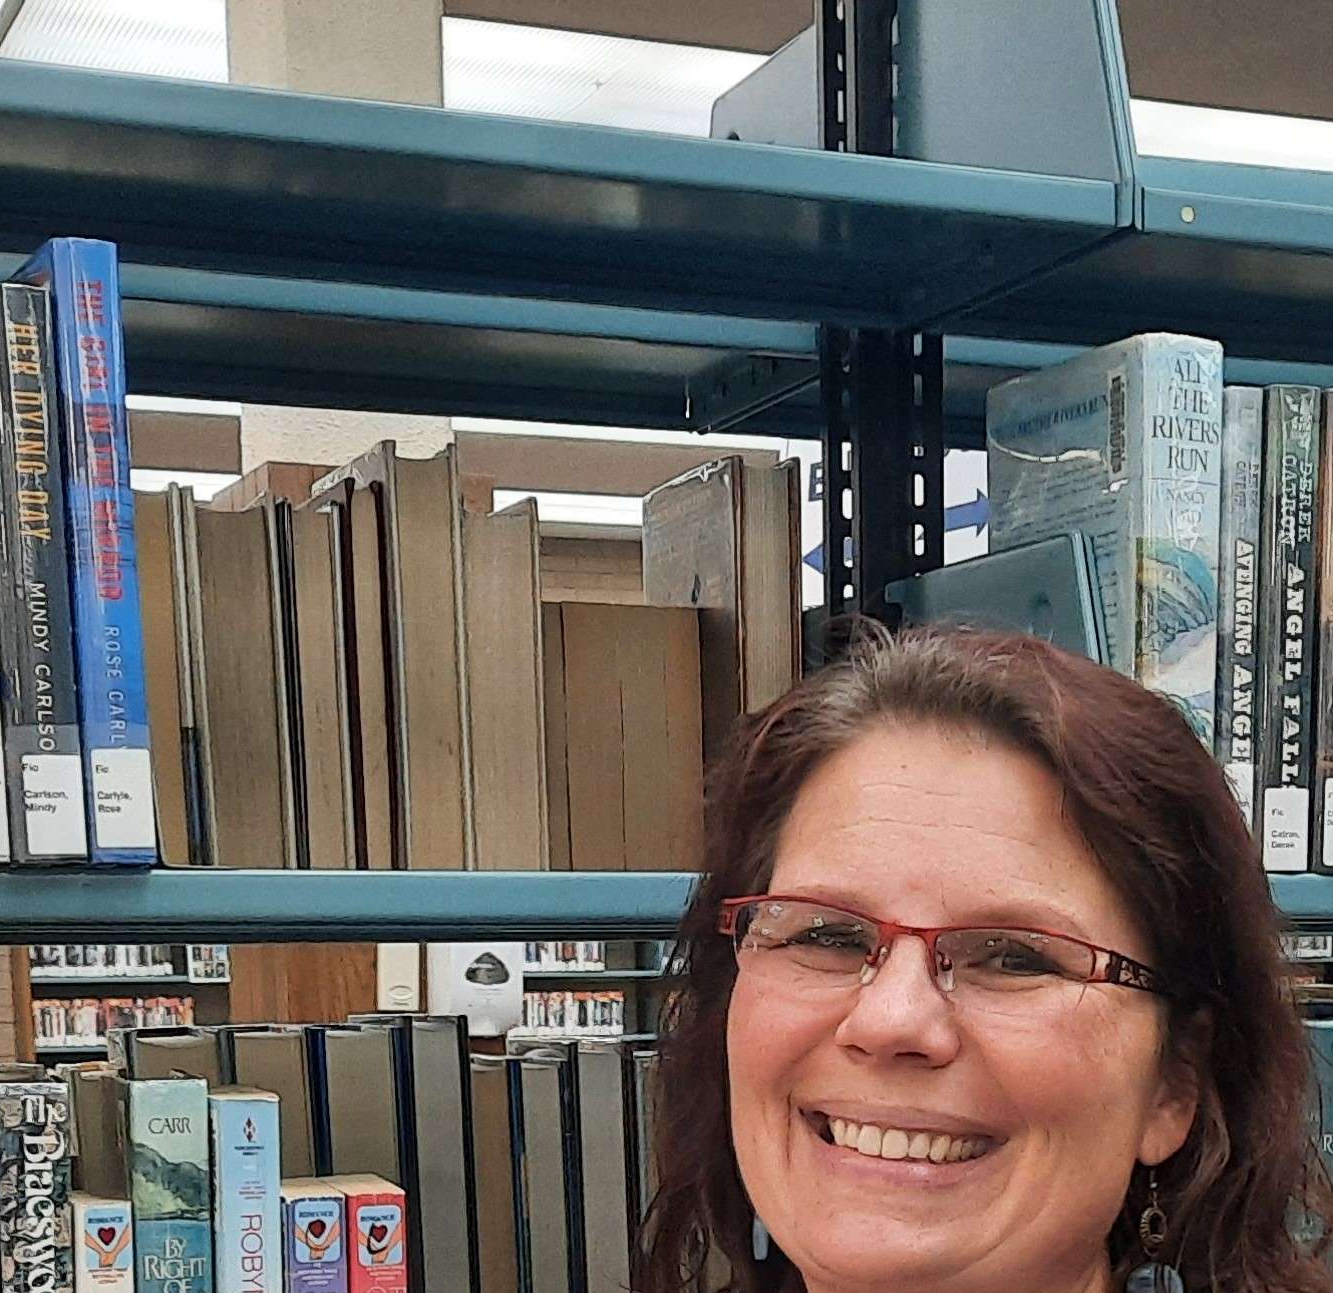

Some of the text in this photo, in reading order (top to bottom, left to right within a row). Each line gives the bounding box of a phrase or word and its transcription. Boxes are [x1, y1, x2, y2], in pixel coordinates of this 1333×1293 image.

[12, 389, 50, 478] DYING
[1151, 413, 1221, 444] RIVERS
[1166, 446, 1212, 474] RUN
[28, 581, 51, 653] MINDY
[1232, 538, 1255, 657] AVENGING
[1282, 561, 1306, 682] ANGEL
[102, 625, 124, 679] ROSE
[147, 1115, 193, 1137] CARR
[142, 1252, 207, 1281] RIGHT
[165, 1237, 188, 1259] BY
